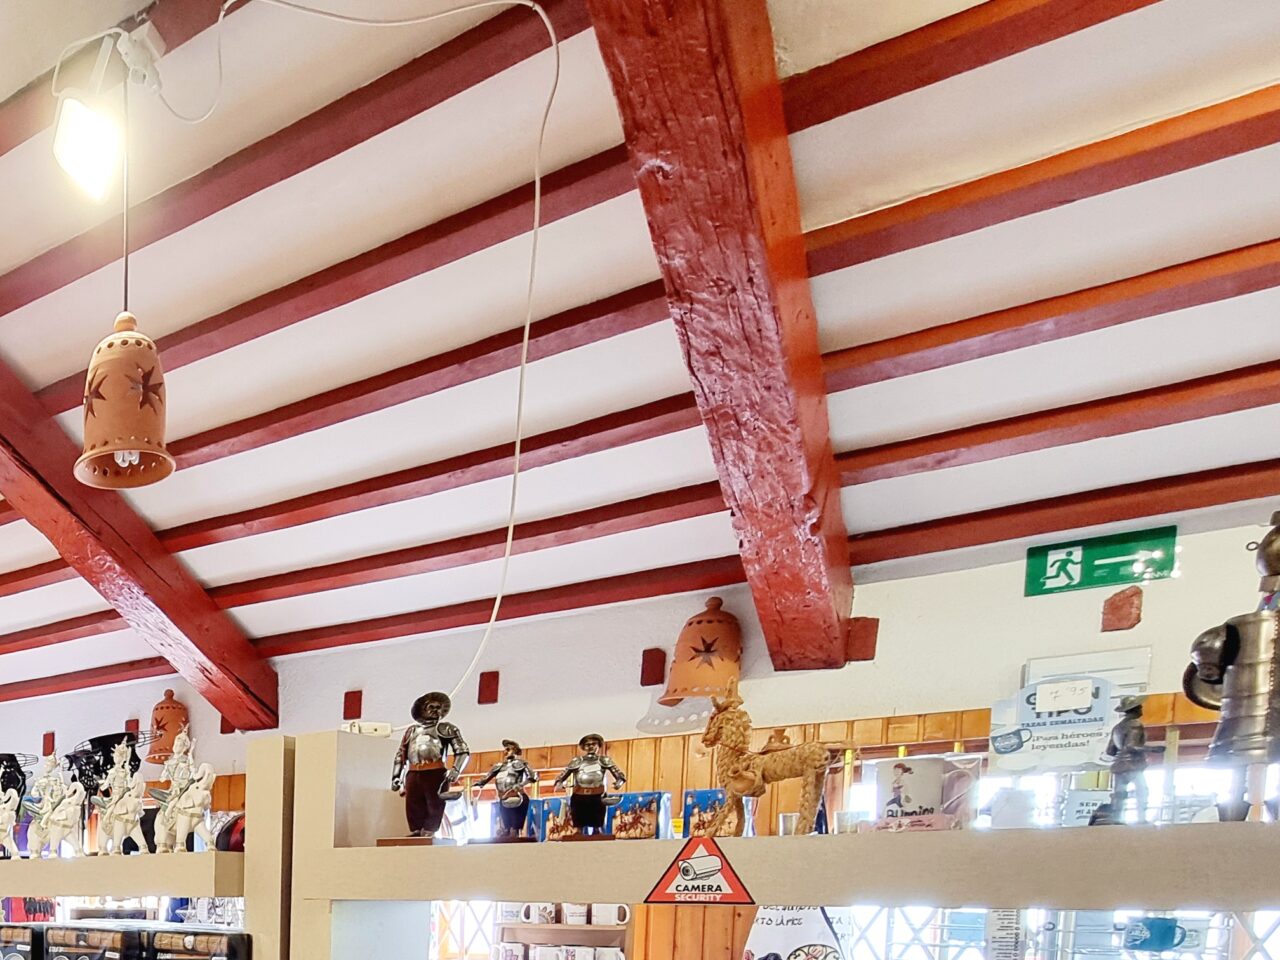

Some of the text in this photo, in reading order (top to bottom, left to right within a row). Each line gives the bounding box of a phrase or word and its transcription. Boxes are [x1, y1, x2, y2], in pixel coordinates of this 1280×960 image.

[1031, 739, 1090, 752] leyendas!
[675, 884, 723, 893] CAMERA
[674, 893, 722, 902] SECURITY
